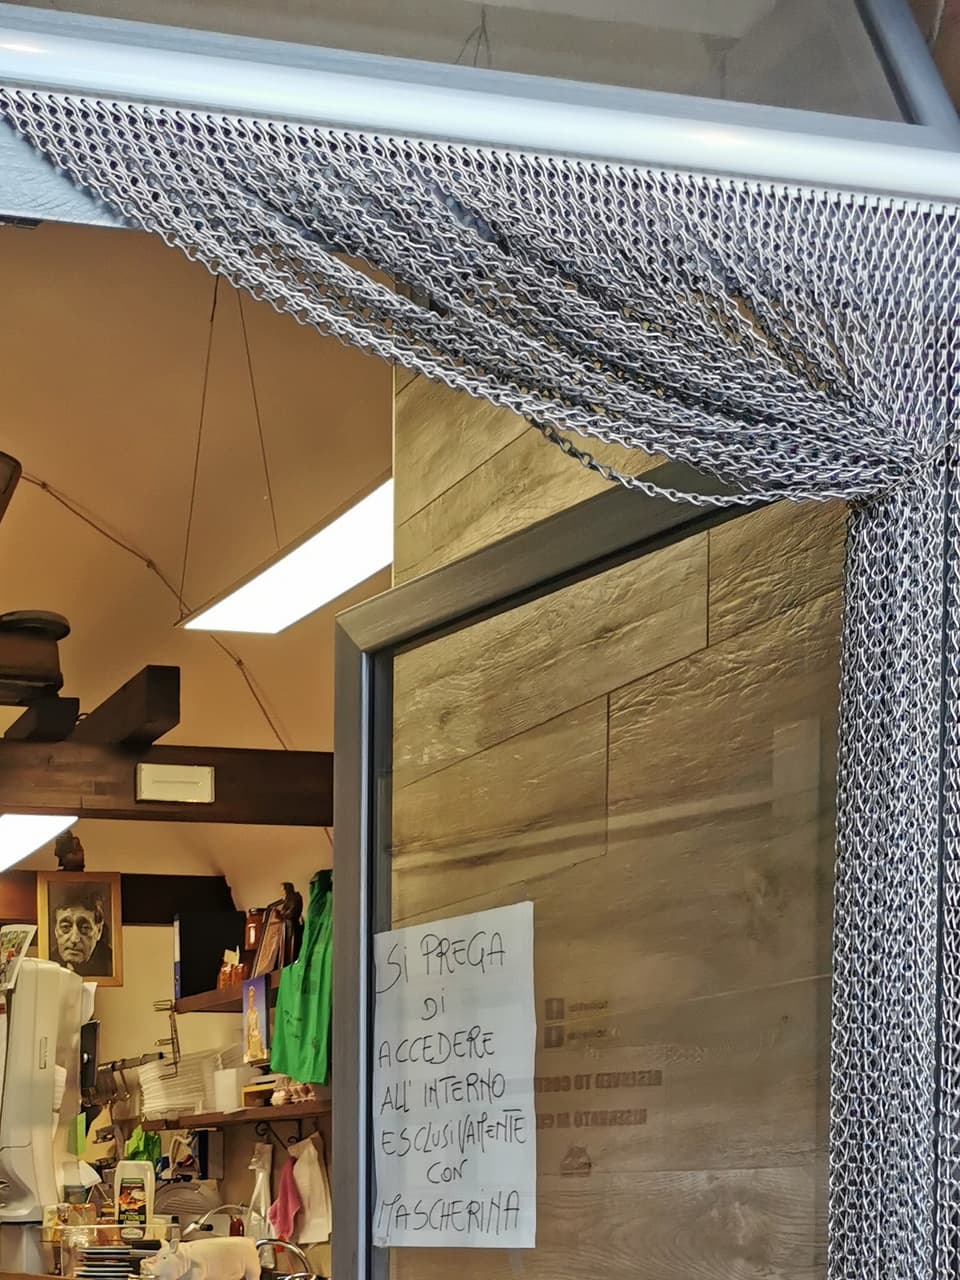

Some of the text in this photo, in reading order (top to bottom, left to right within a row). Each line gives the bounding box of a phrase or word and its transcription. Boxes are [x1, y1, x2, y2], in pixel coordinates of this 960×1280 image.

[420, 931, 506, 975] PREGA
[379, 1025, 495, 1068] ACCEDERE
[382, 1109, 527, 1157] ESCLUSIVAMENTE
[427, 1159, 468, 1184] CON
[378, 1189, 520, 1237] MASCHERINA
